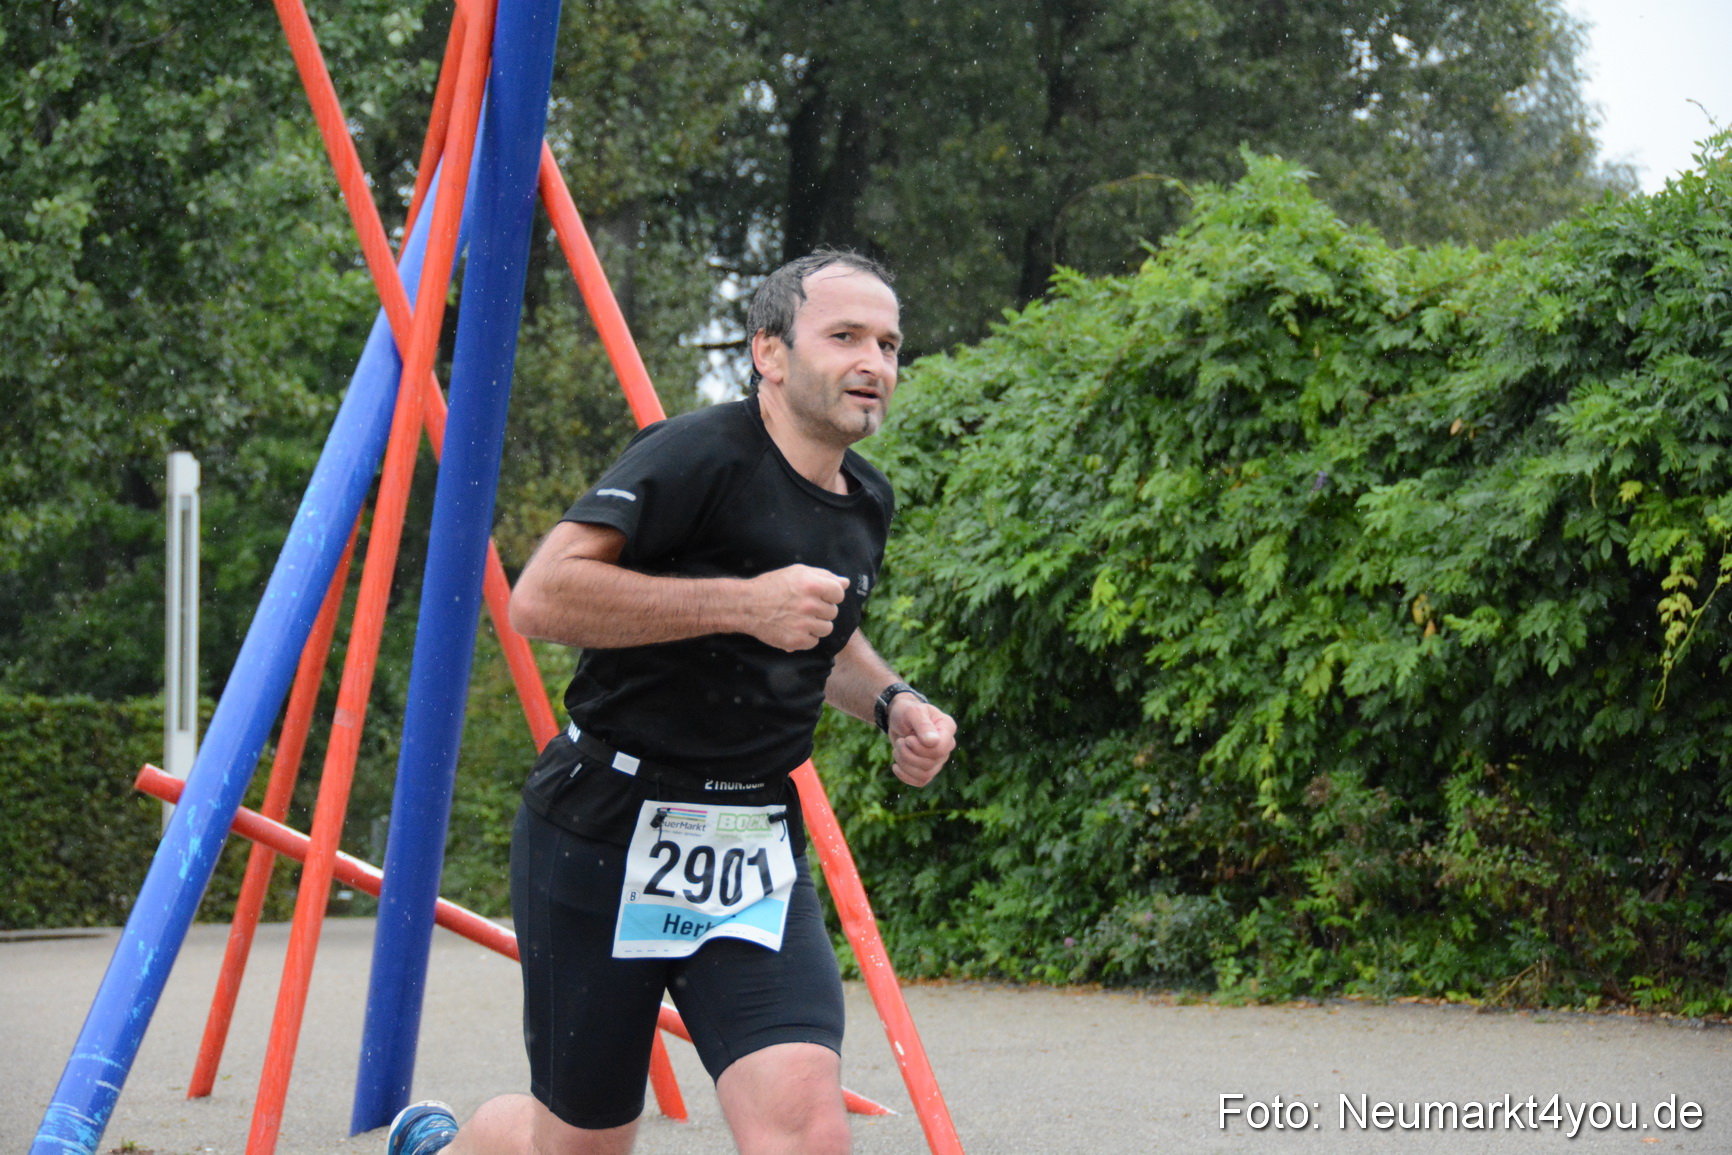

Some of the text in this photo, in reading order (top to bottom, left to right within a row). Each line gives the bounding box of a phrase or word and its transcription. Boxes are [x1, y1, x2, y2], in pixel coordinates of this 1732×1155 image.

[658, 820, 707, 833] euerMarkt
[718, 812, 771, 832] BOCK
[643, 840, 774, 907] 2901
